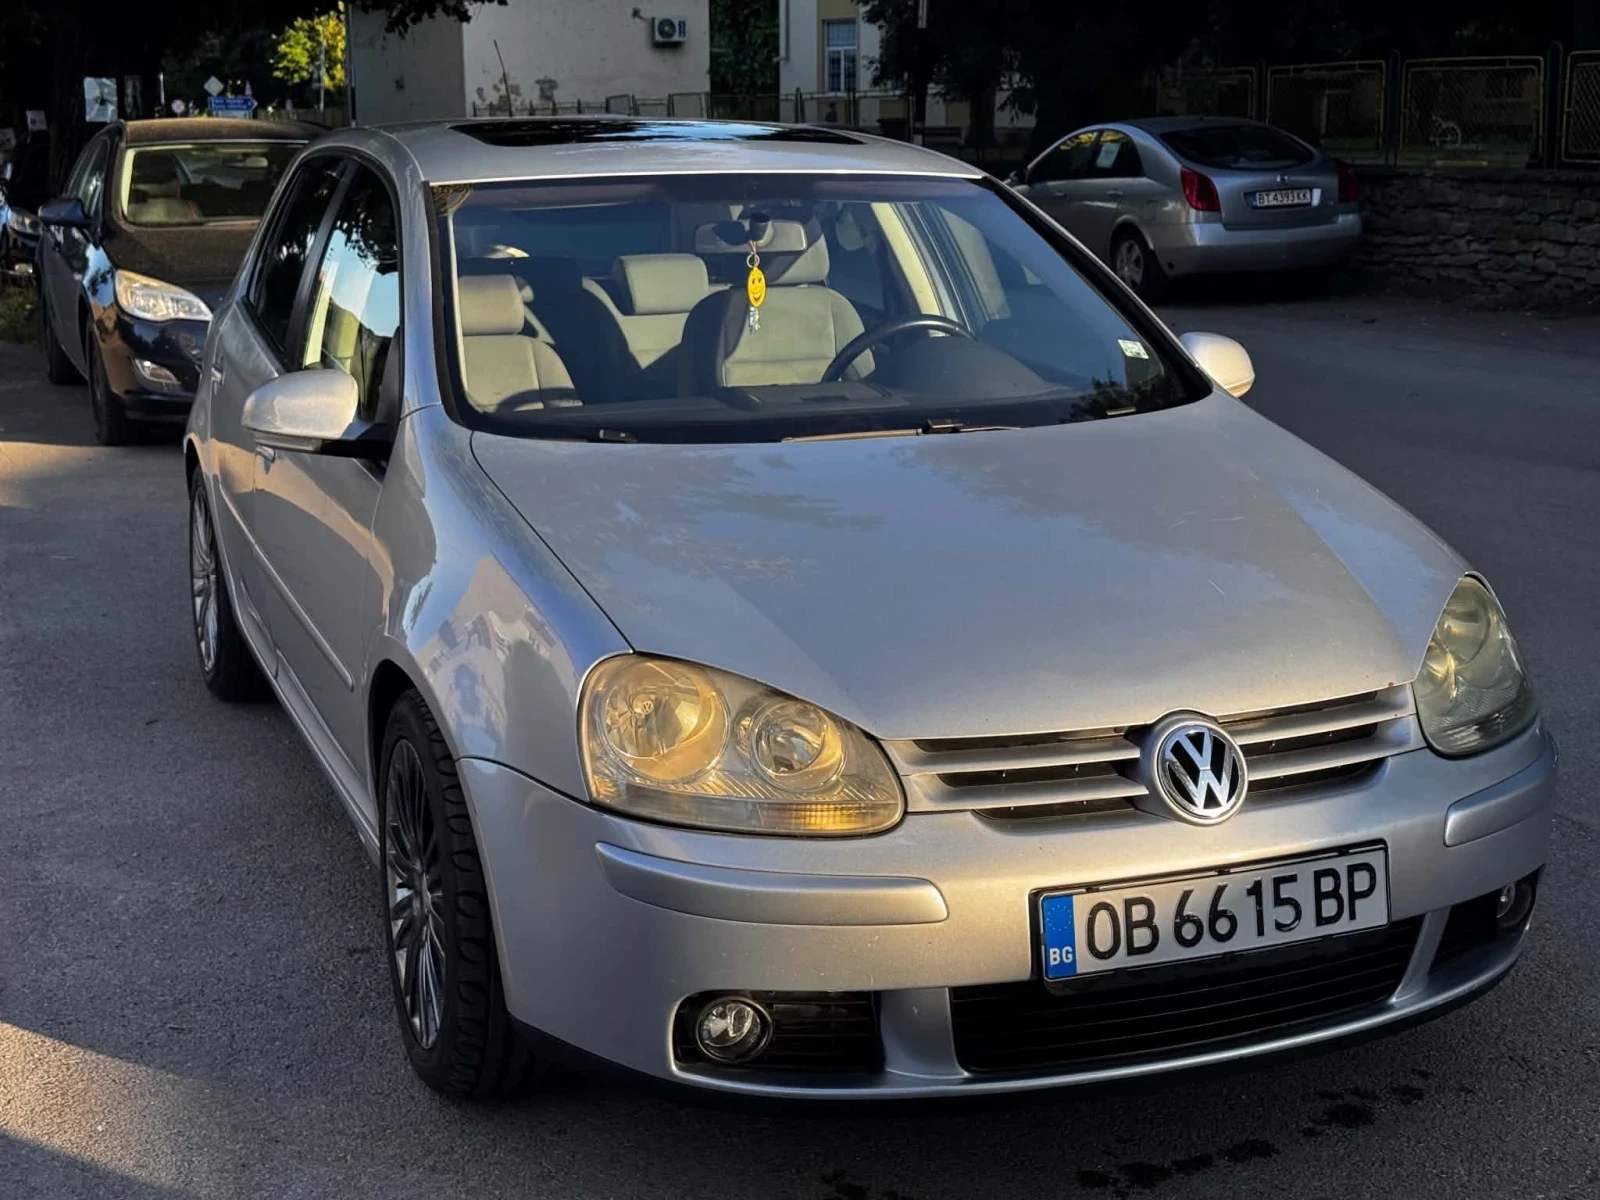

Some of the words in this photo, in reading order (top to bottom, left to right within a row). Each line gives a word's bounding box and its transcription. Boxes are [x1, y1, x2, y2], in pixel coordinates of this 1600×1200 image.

[1159, 723, 1245, 819] VW
[1050, 946, 1073, 966] BG
[1086, 896, 1160, 960] OB
[1173, 873, 1303, 948] 6615
[1313, 861, 1378, 928] BP
